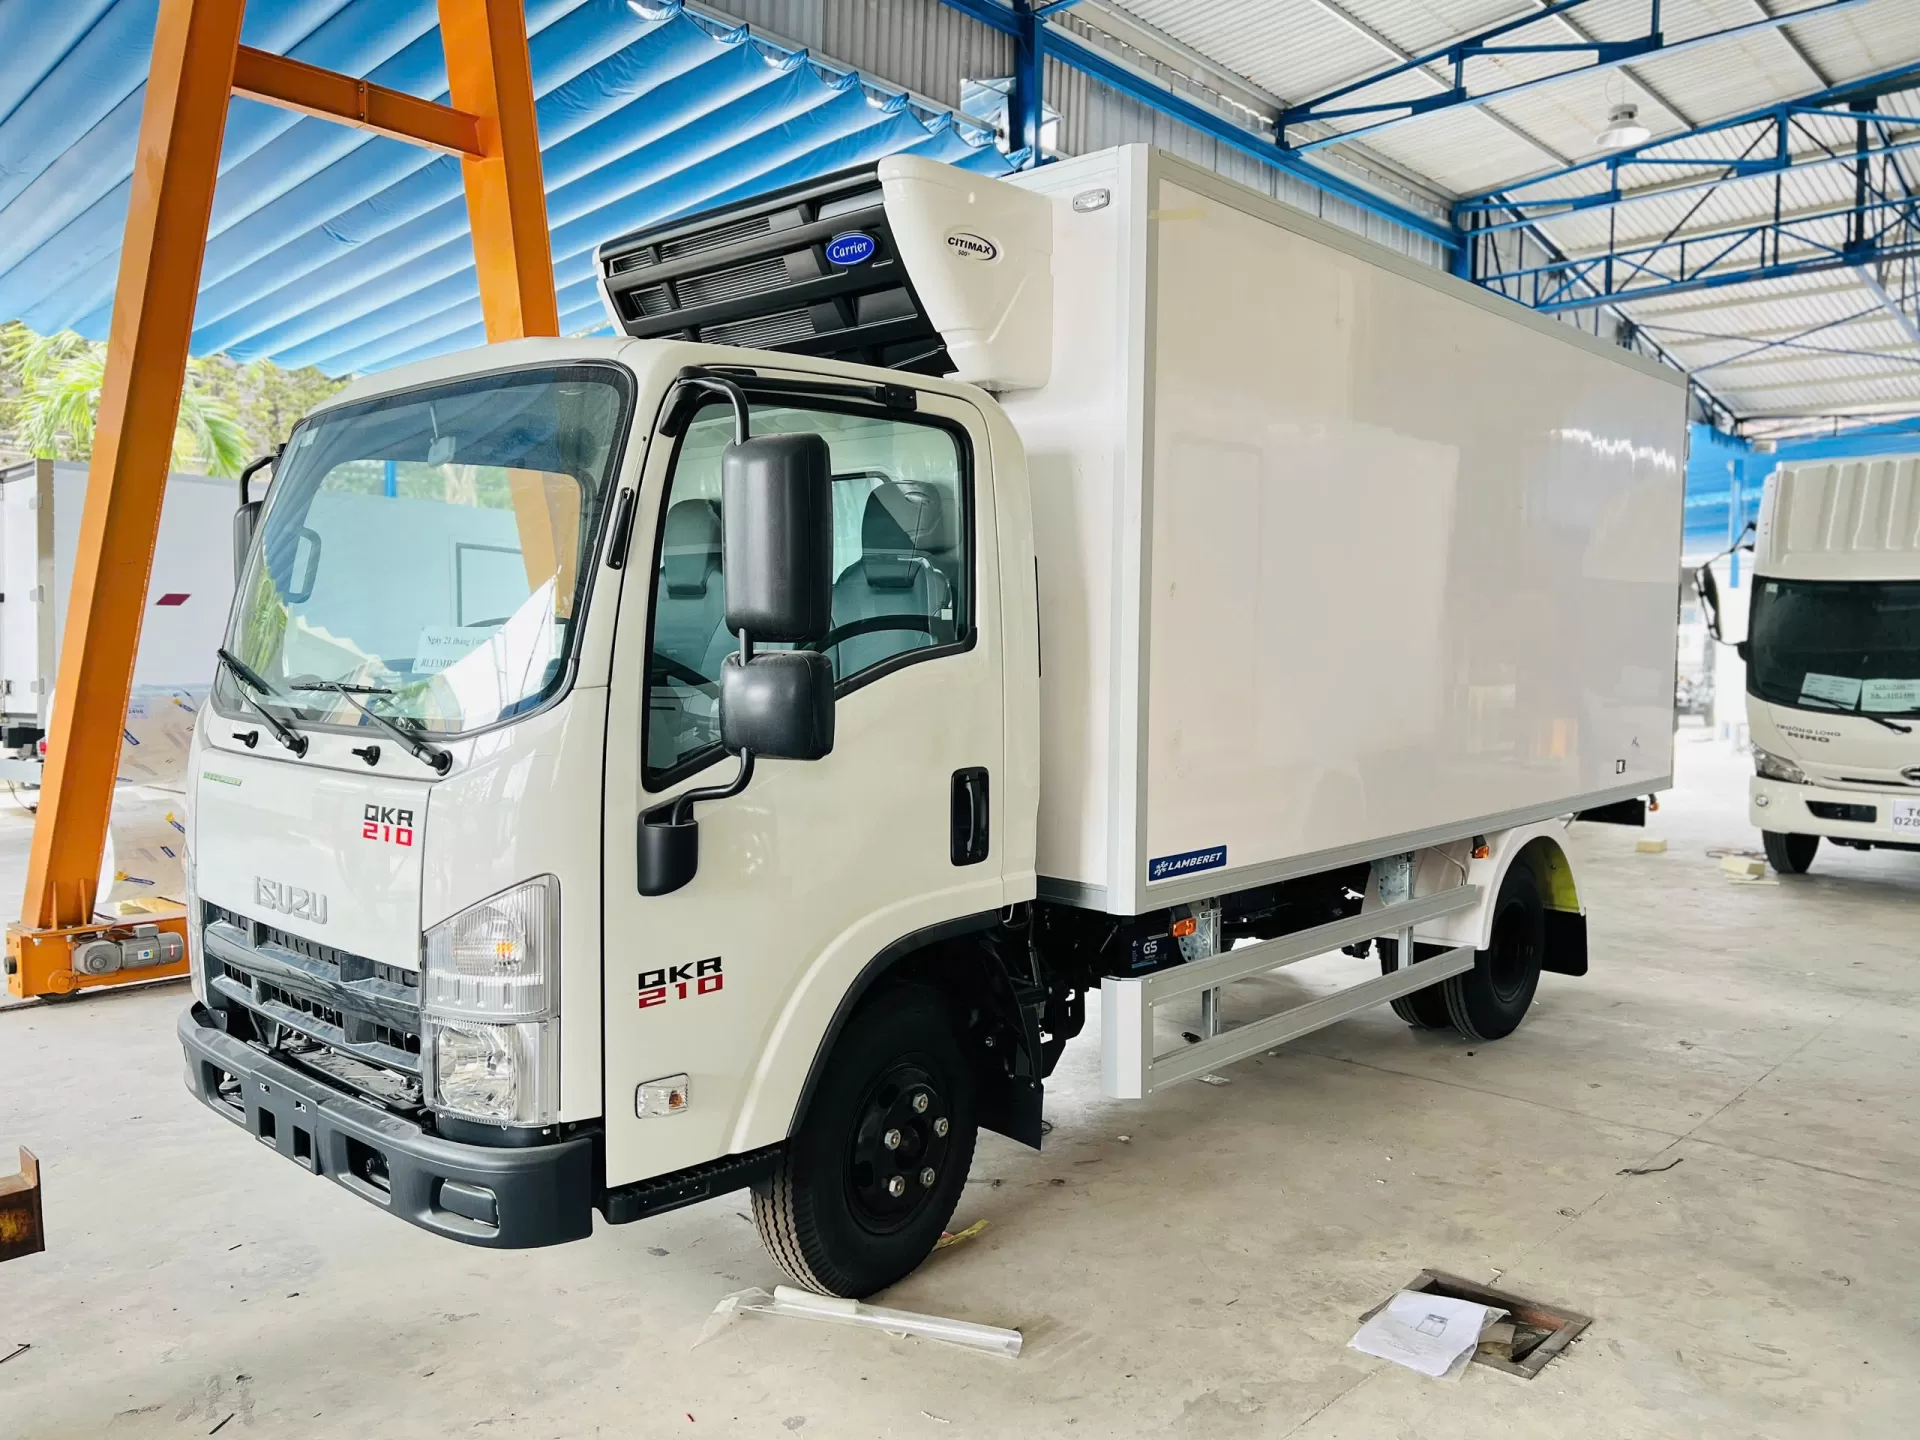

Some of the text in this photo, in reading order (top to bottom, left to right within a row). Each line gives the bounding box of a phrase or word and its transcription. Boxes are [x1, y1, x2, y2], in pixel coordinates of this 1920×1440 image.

[833, 241, 867, 258] Carrier
[947, 236, 991, 255] CITIMAX
[1787, 731, 1830, 743] HINO
[364, 803, 414, 828] QKR
[362, 821, 413, 847] 210
[1167, 852, 1223, 871] LAMBERET
[253, 875, 328, 925] ISUZU
[1143, 940, 1158, 955] GS
[638, 955, 723, 990] QKR
[638, 973, 723, 1009] 210
